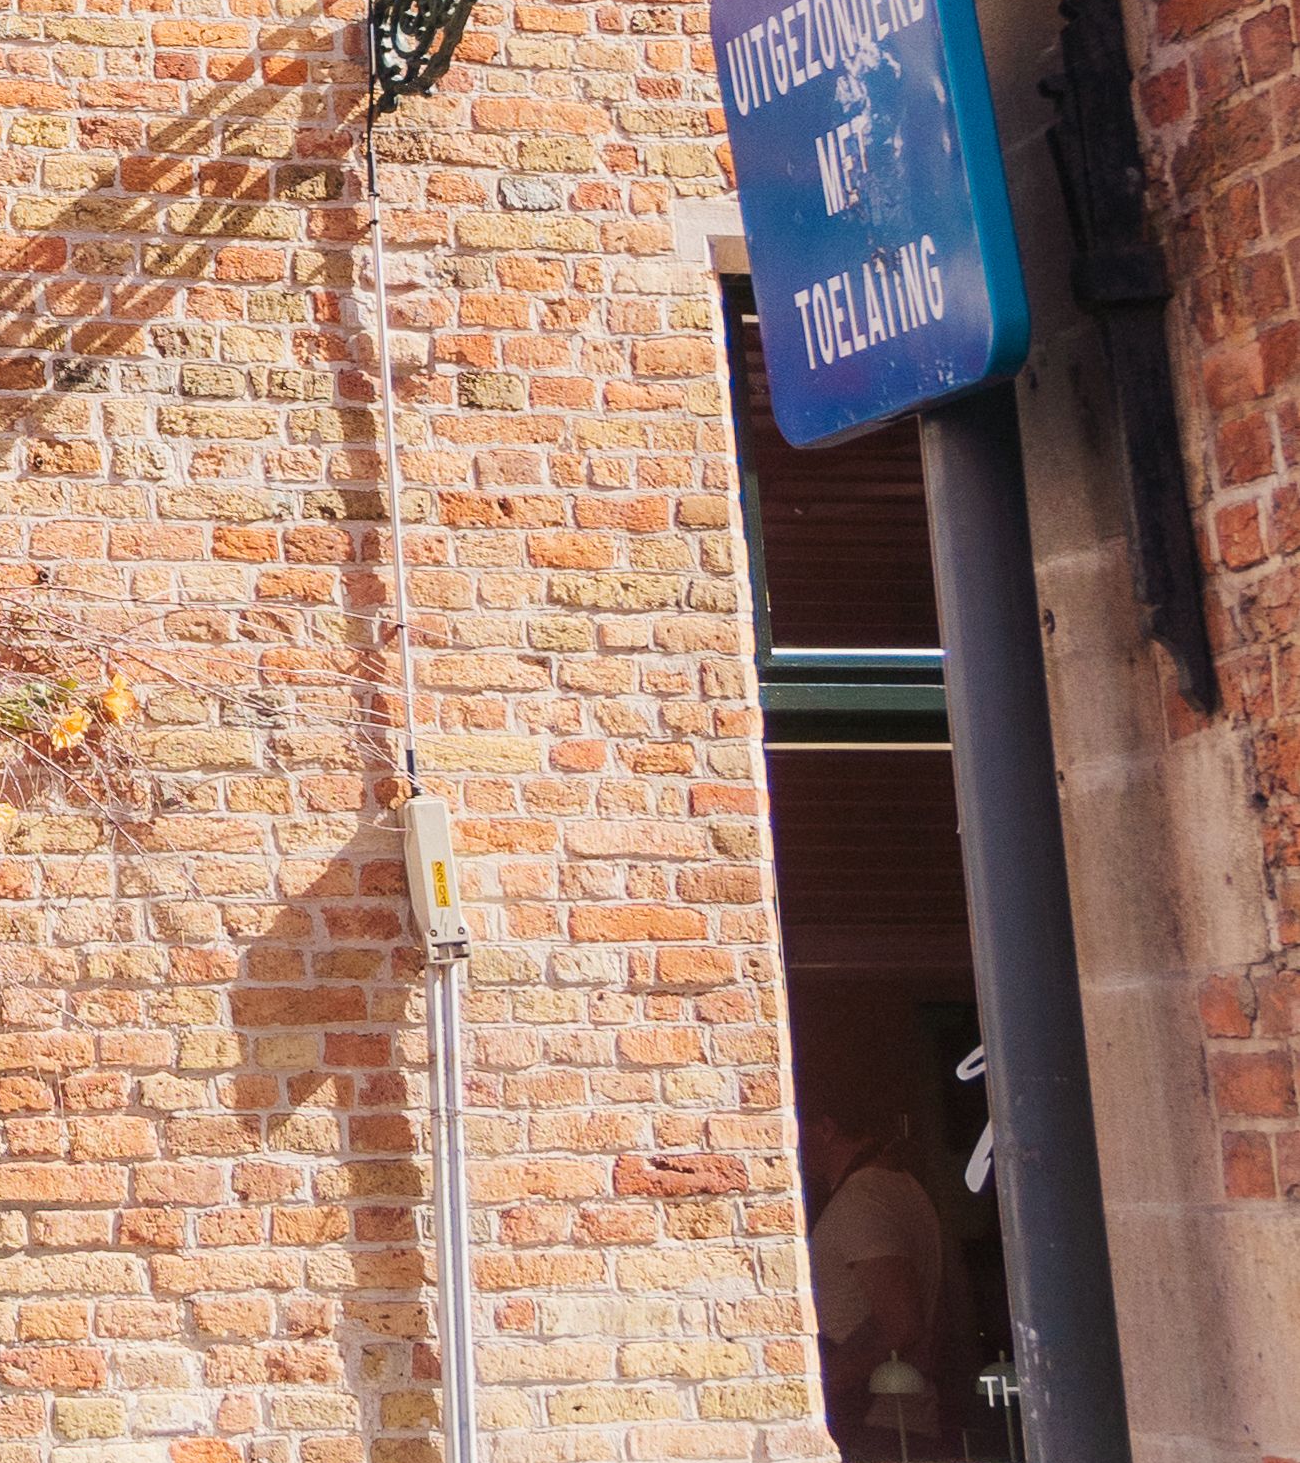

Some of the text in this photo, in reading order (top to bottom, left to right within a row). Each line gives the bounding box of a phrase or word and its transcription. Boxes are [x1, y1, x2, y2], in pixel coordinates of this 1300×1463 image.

[814, 115, 869, 217] MET
[794, 234, 944, 371] TOELATING
[434, 861, 448, 906] 2204
